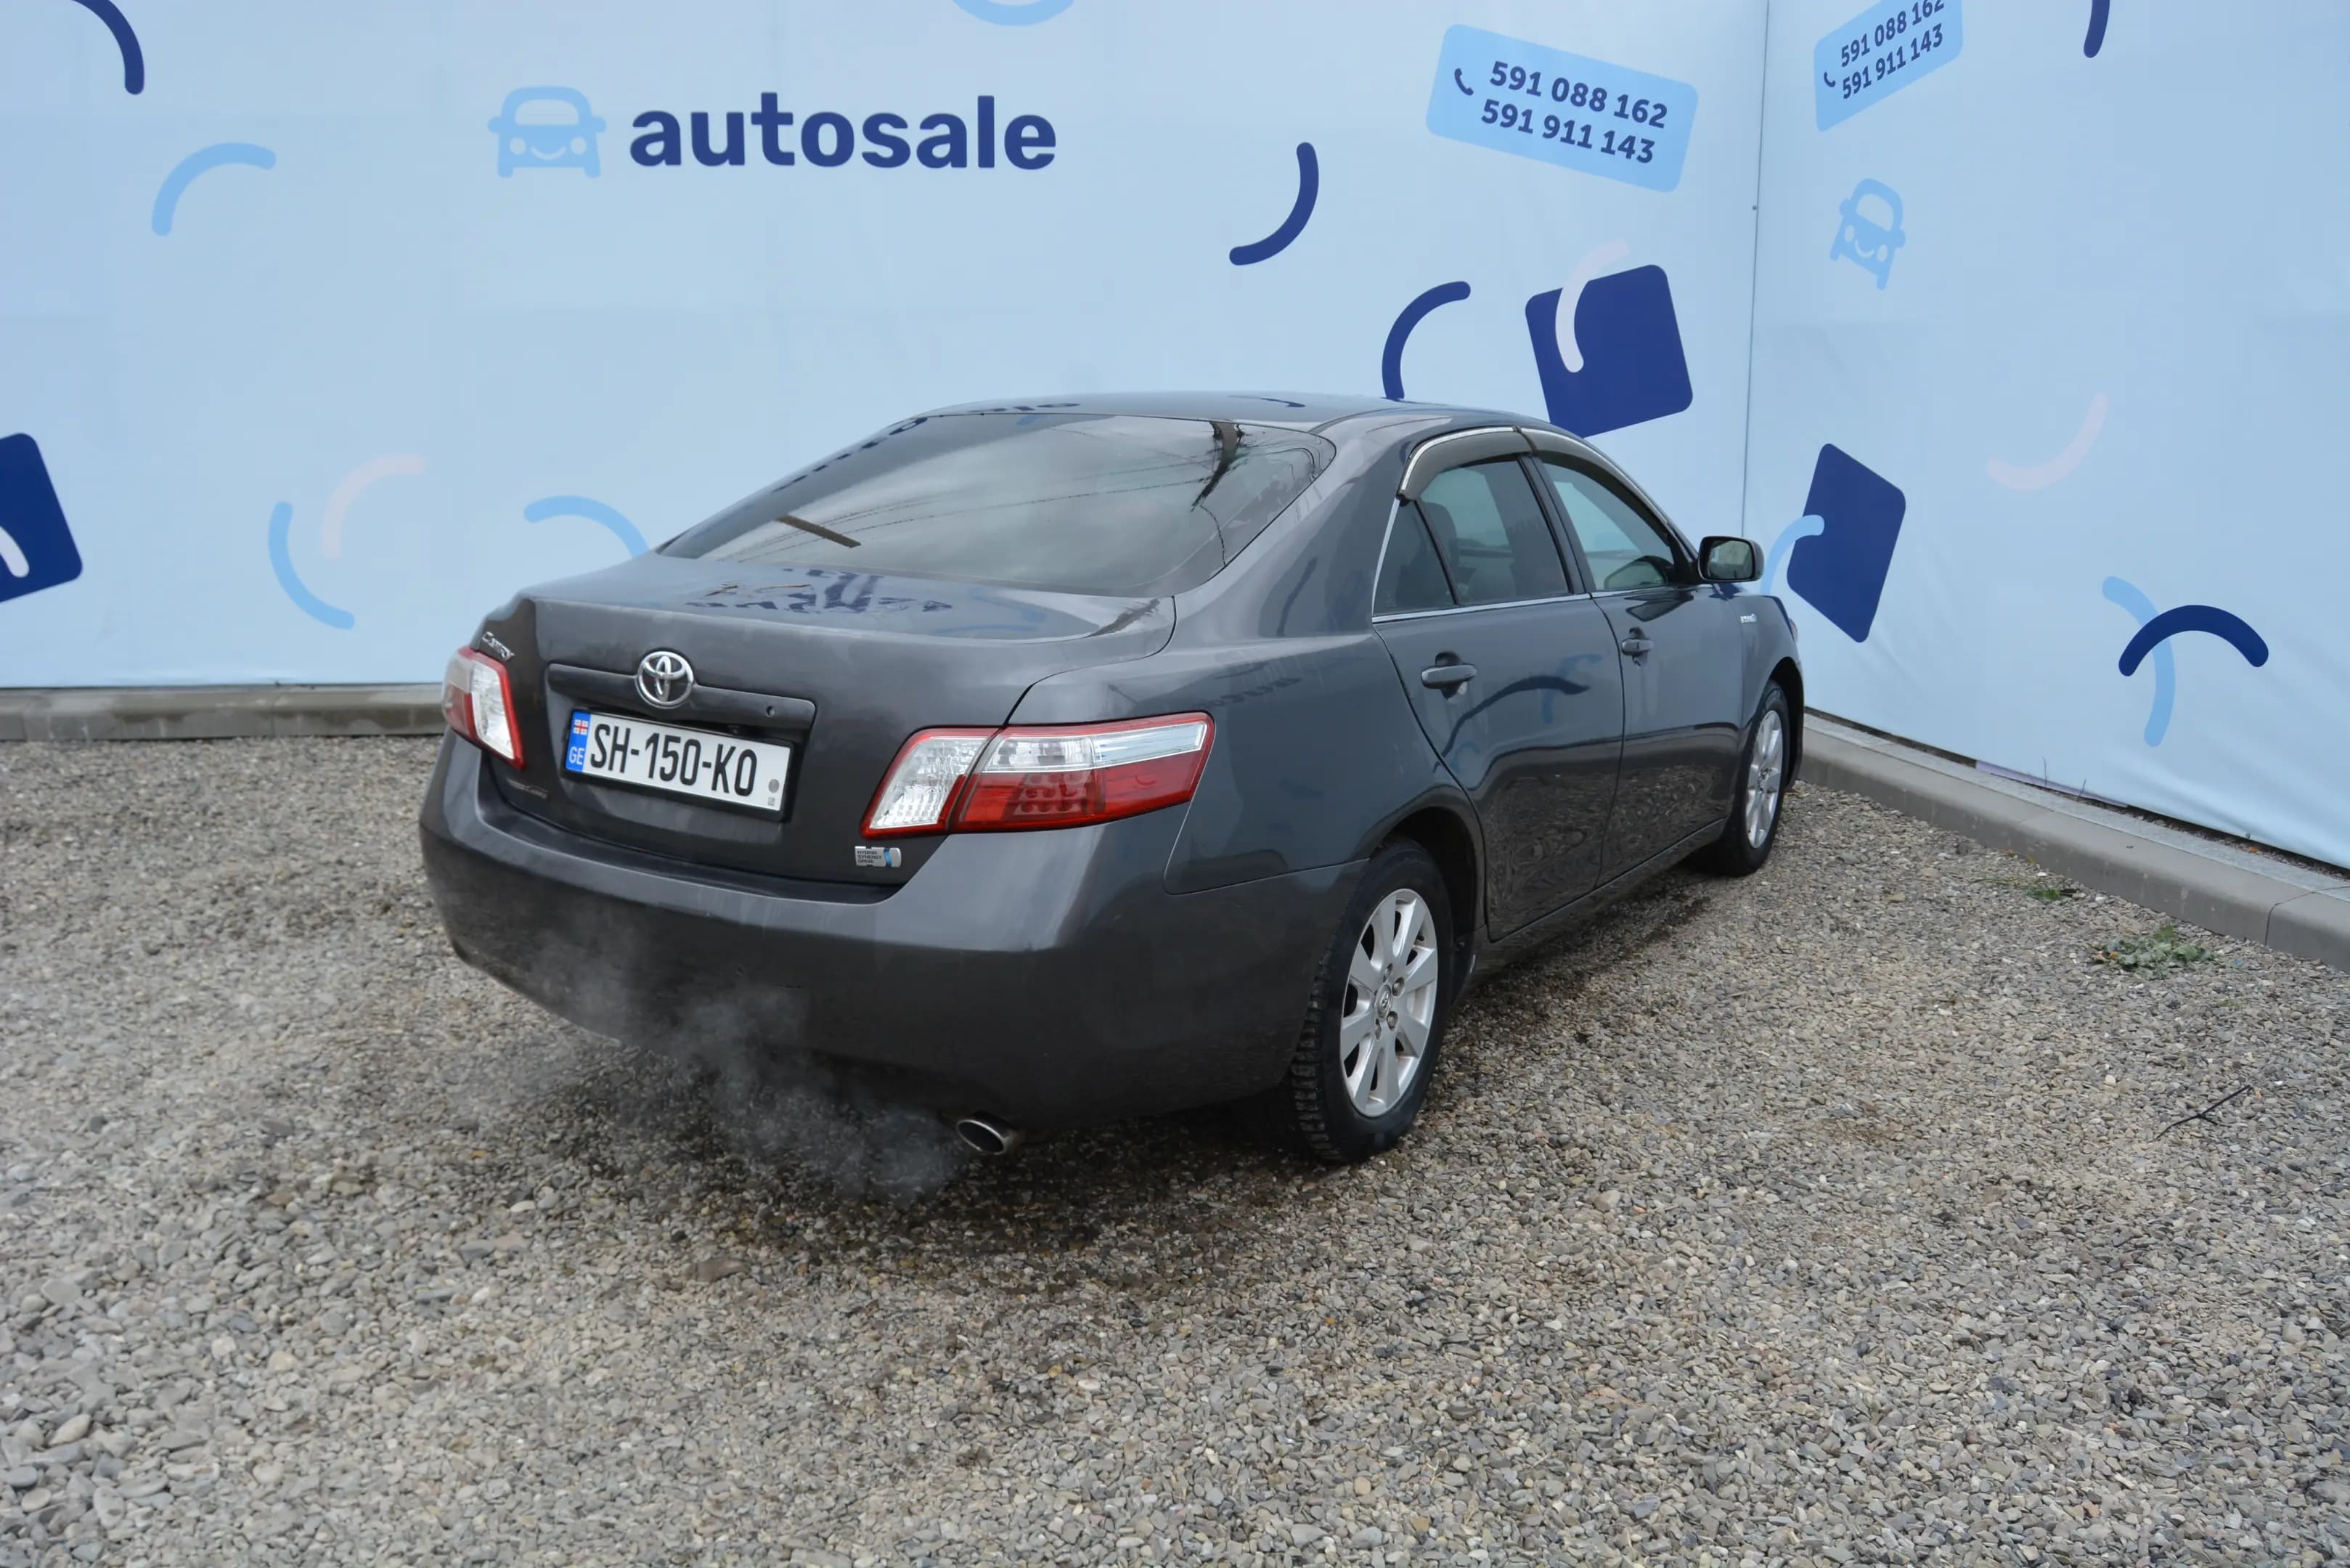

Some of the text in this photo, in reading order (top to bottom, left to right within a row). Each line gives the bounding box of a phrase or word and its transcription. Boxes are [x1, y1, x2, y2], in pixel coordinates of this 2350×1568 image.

[1841, 33, 1871, 68] 591
[1874, 10, 1907, 47] 088
[1843, 23, 1943, 99] 591 911 143
[1490, 60, 1668, 129] 591 088 162
[630, 92, 1057, 170] autosale
[1481, 98, 1655, 164] 591 911 143
[568, 746, 584, 765] GE
